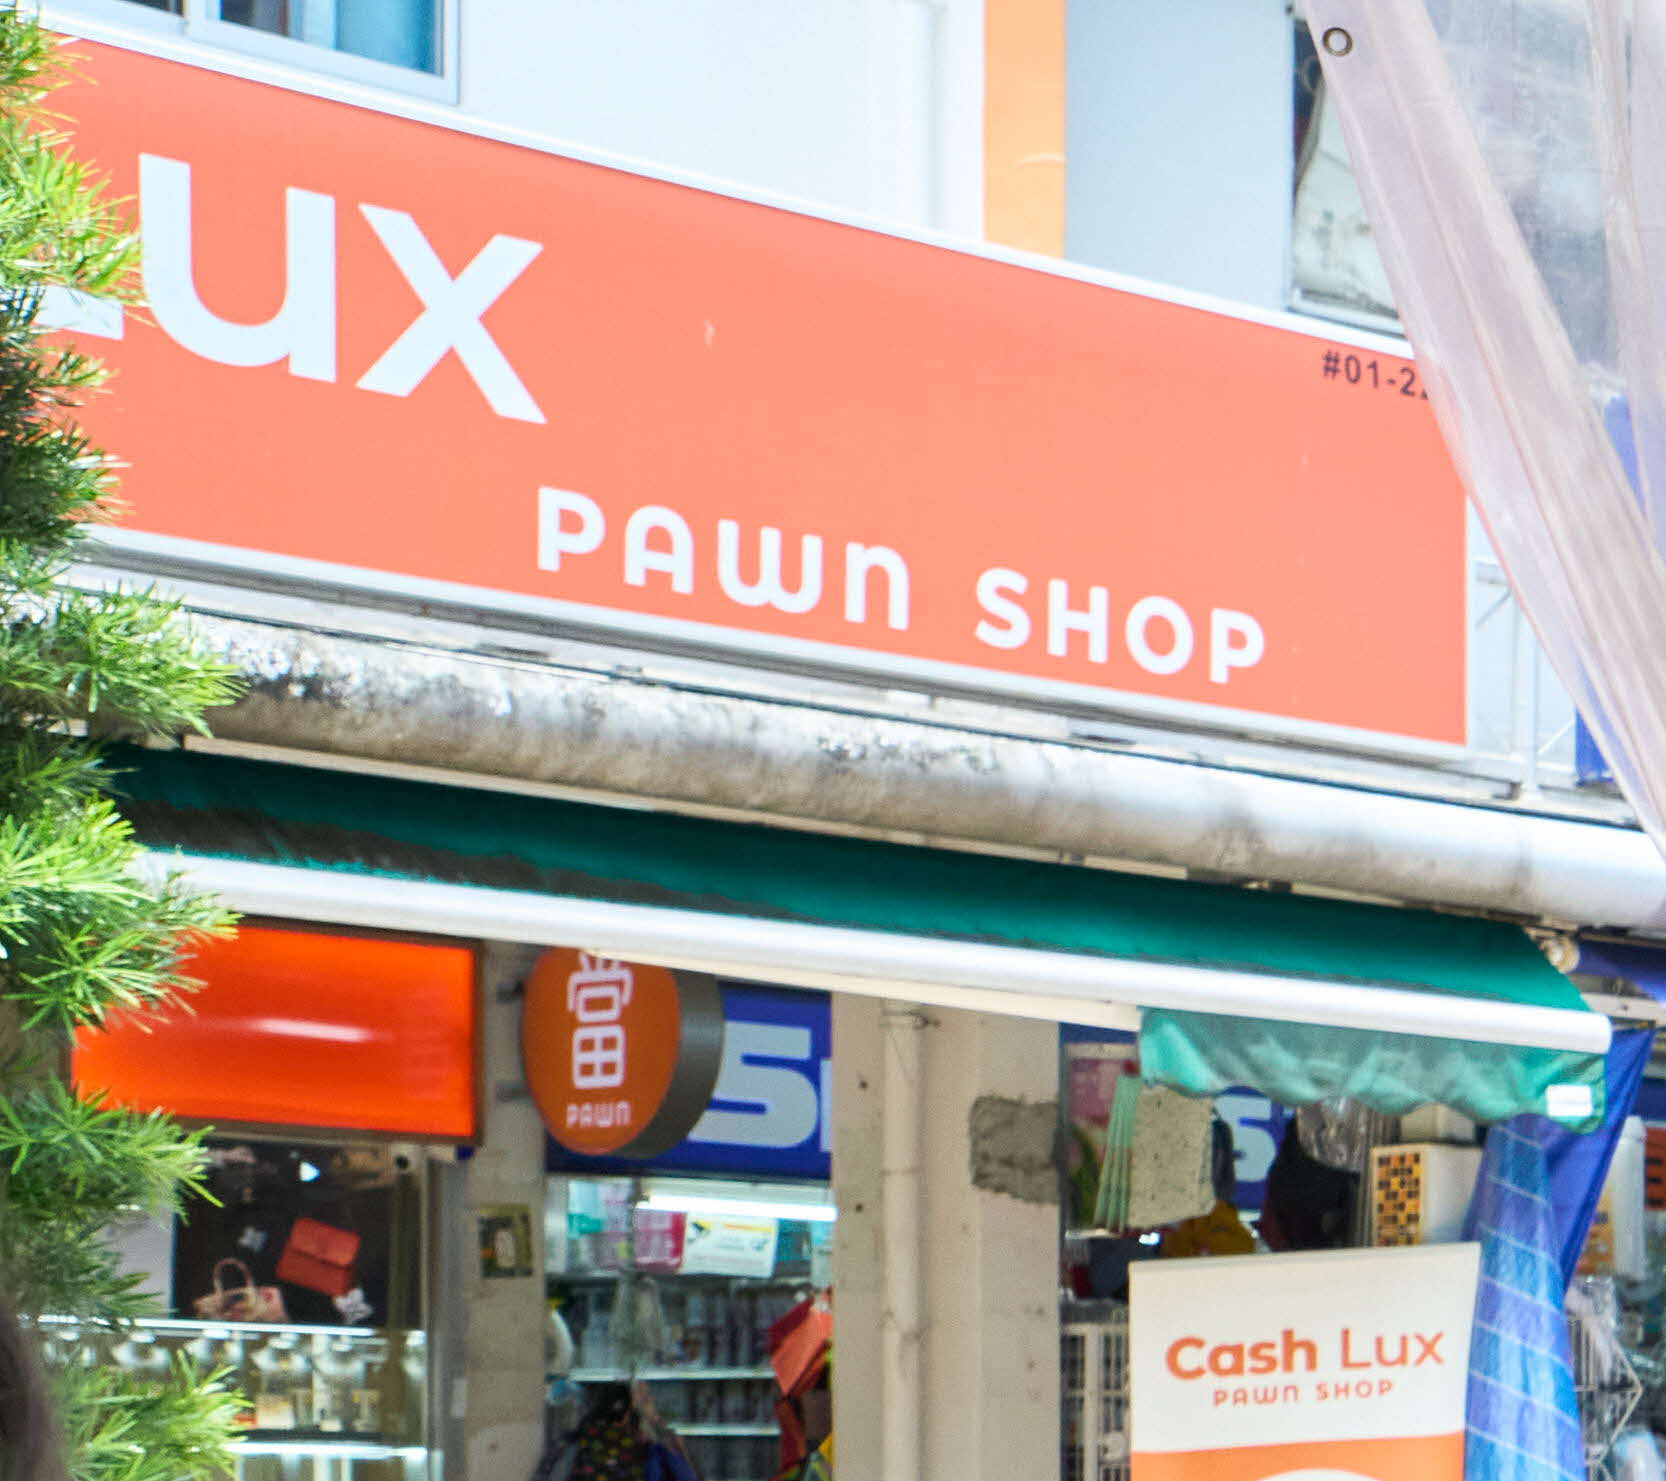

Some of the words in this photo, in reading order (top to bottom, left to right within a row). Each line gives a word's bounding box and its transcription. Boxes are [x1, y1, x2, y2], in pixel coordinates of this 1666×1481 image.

[1322, 350, 1428, 400] #01-2
[537, 486, 910, 631] PAWN
[974, 566, 1266, 684] SHOP
[566, 1100, 632, 1128] PAWN
[1164, 1329, 1318, 1380] Cash
[1340, 1328, 1446, 1370] Lux
[1212, 1384, 1299, 1407] PAWN
[1315, 1380, 1394, 1400] SHOP
